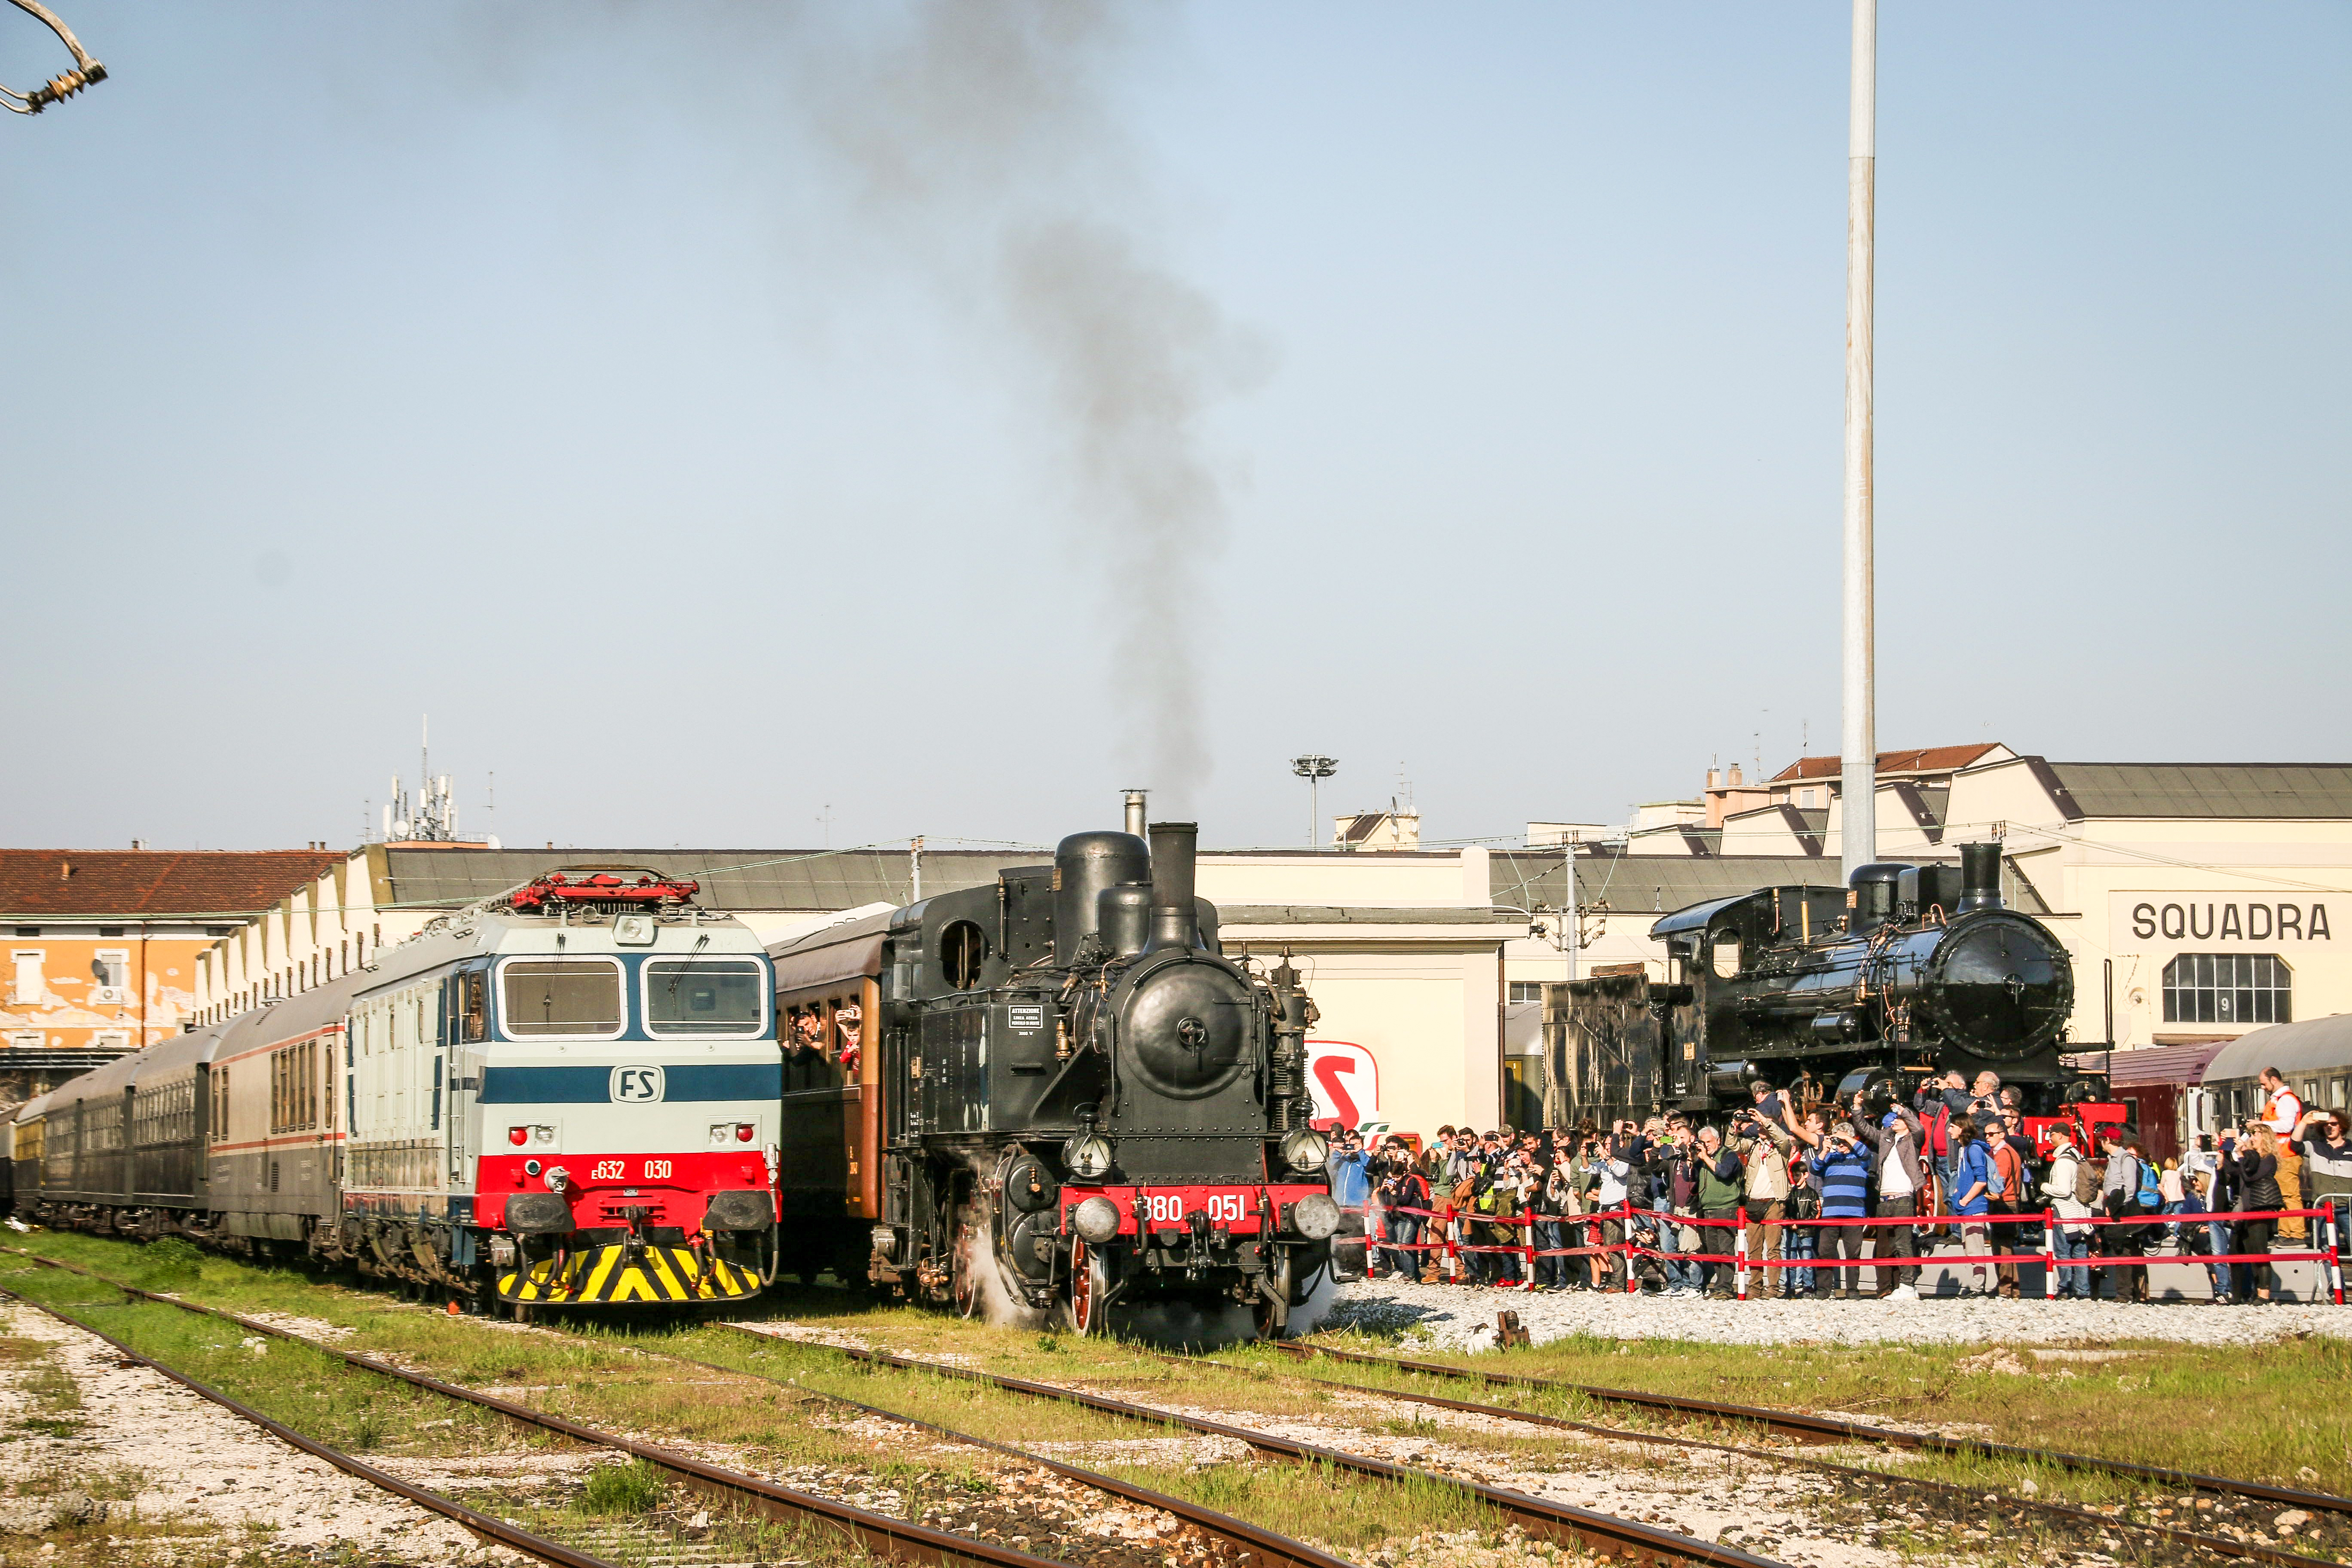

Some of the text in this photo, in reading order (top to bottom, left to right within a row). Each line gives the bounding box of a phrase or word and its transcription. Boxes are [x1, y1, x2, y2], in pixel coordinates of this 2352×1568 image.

[2132, 903, 2331, 940] SQUADRA
[2221, 997, 2229, 1011] 9
[620, 1070, 654, 1098] FS
[591, 1160, 672, 1179] E632 030
[1208, 1195, 1245, 1222] 051
